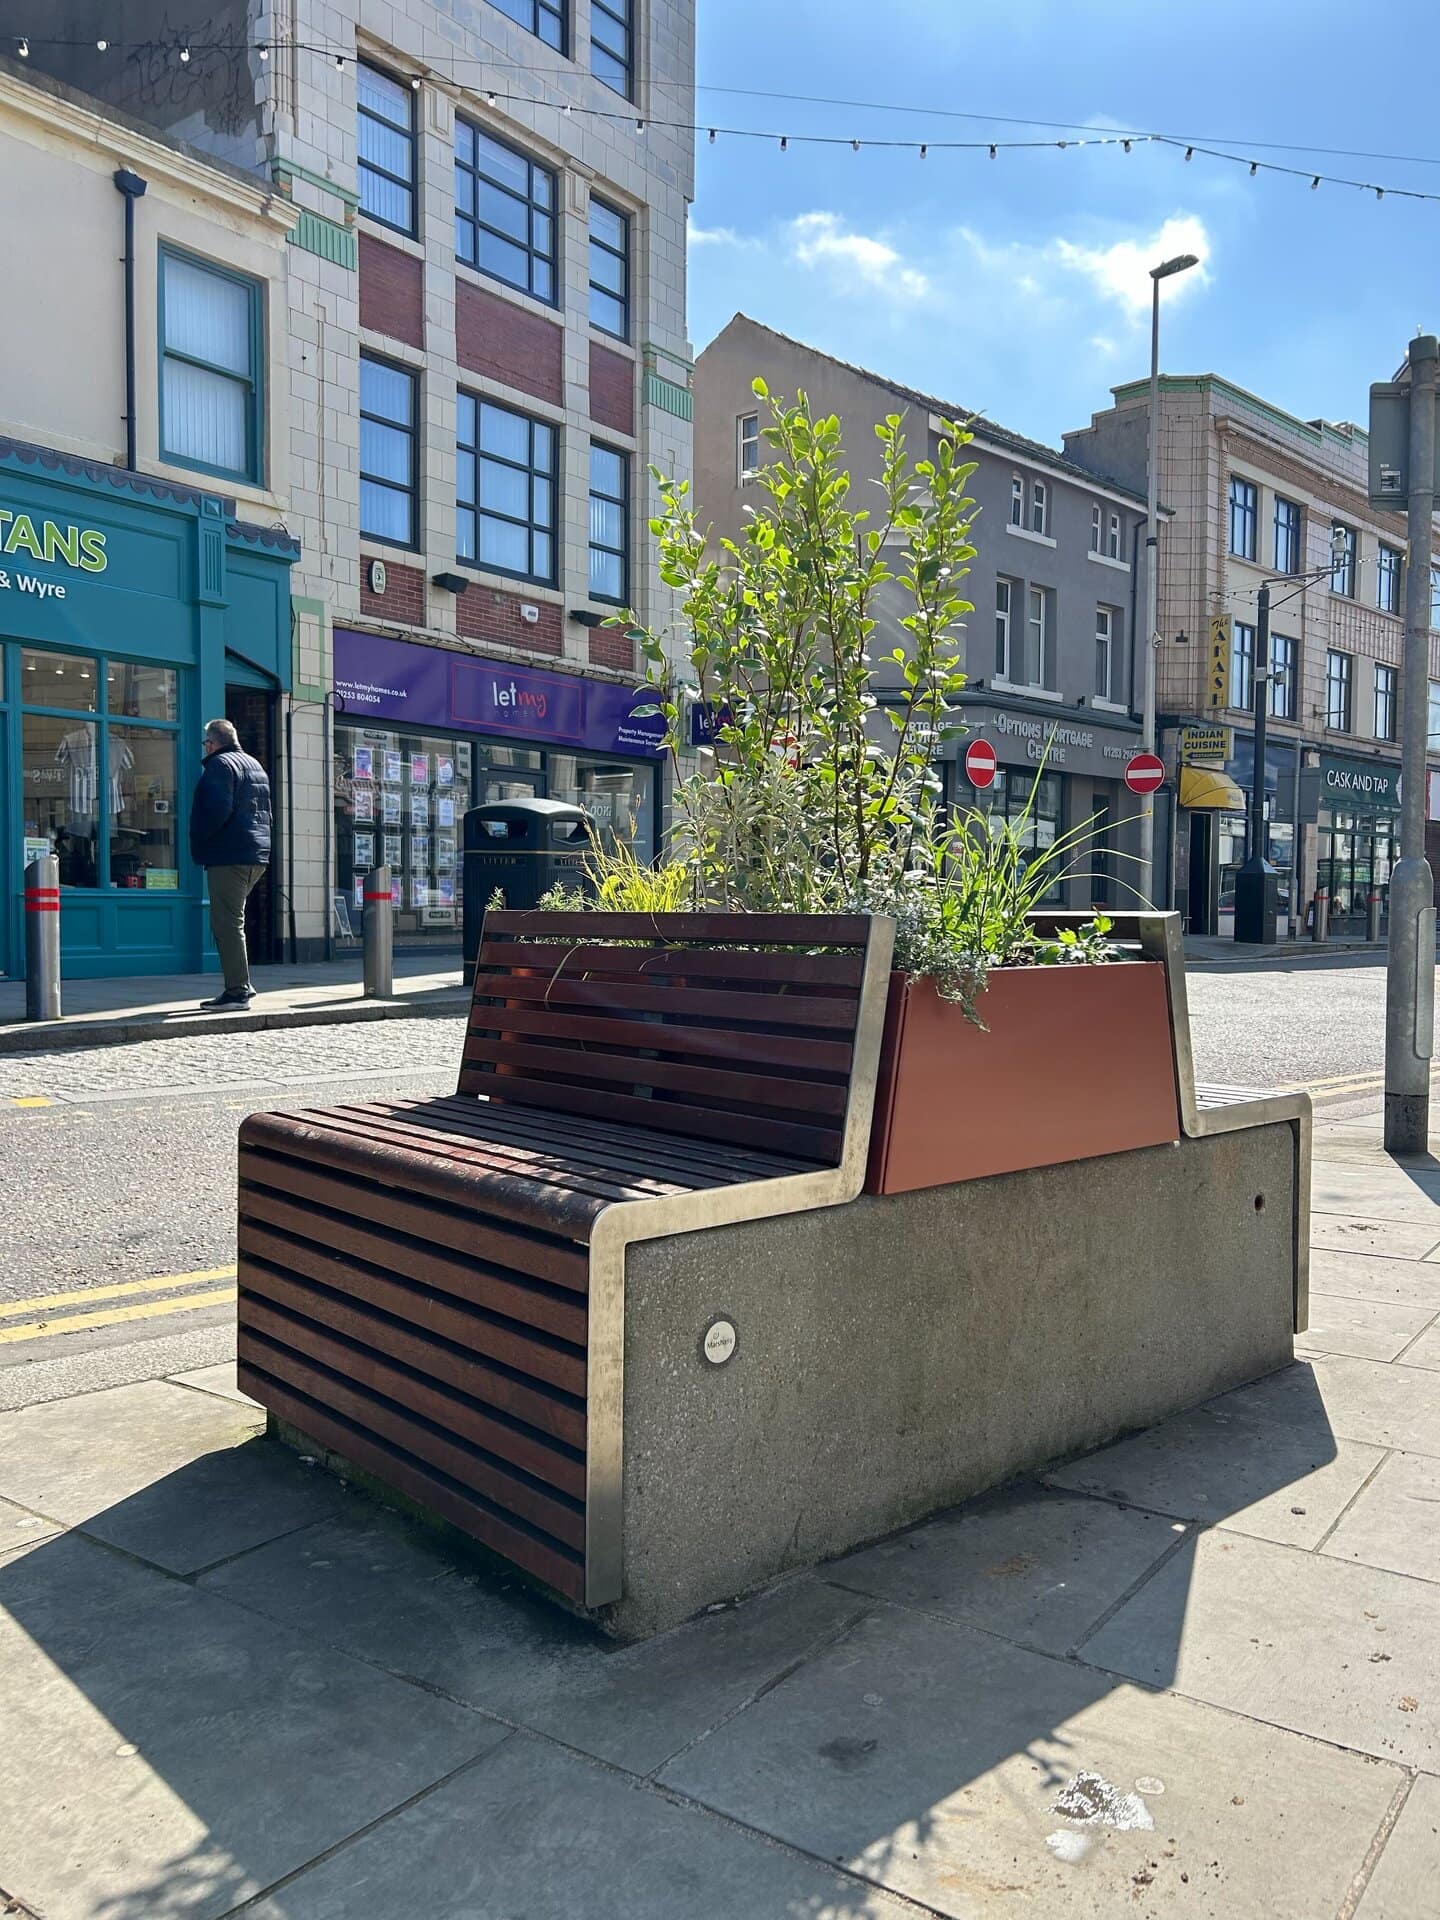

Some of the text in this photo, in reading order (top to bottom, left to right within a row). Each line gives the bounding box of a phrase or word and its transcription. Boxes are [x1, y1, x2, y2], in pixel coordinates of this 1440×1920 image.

[16, 574, 66, 599] Wyre
[1211, 618, 1228, 630] The
[1212, 630, 1226, 706] AKASH
[998, 714, 1041, 739] OPTIONS
[1187, 730, 1224, 739] INDIAN
[1184, 740, 1227, 749] CUISINE
[1327, 769, 1389, 794] CASK AND TAP
